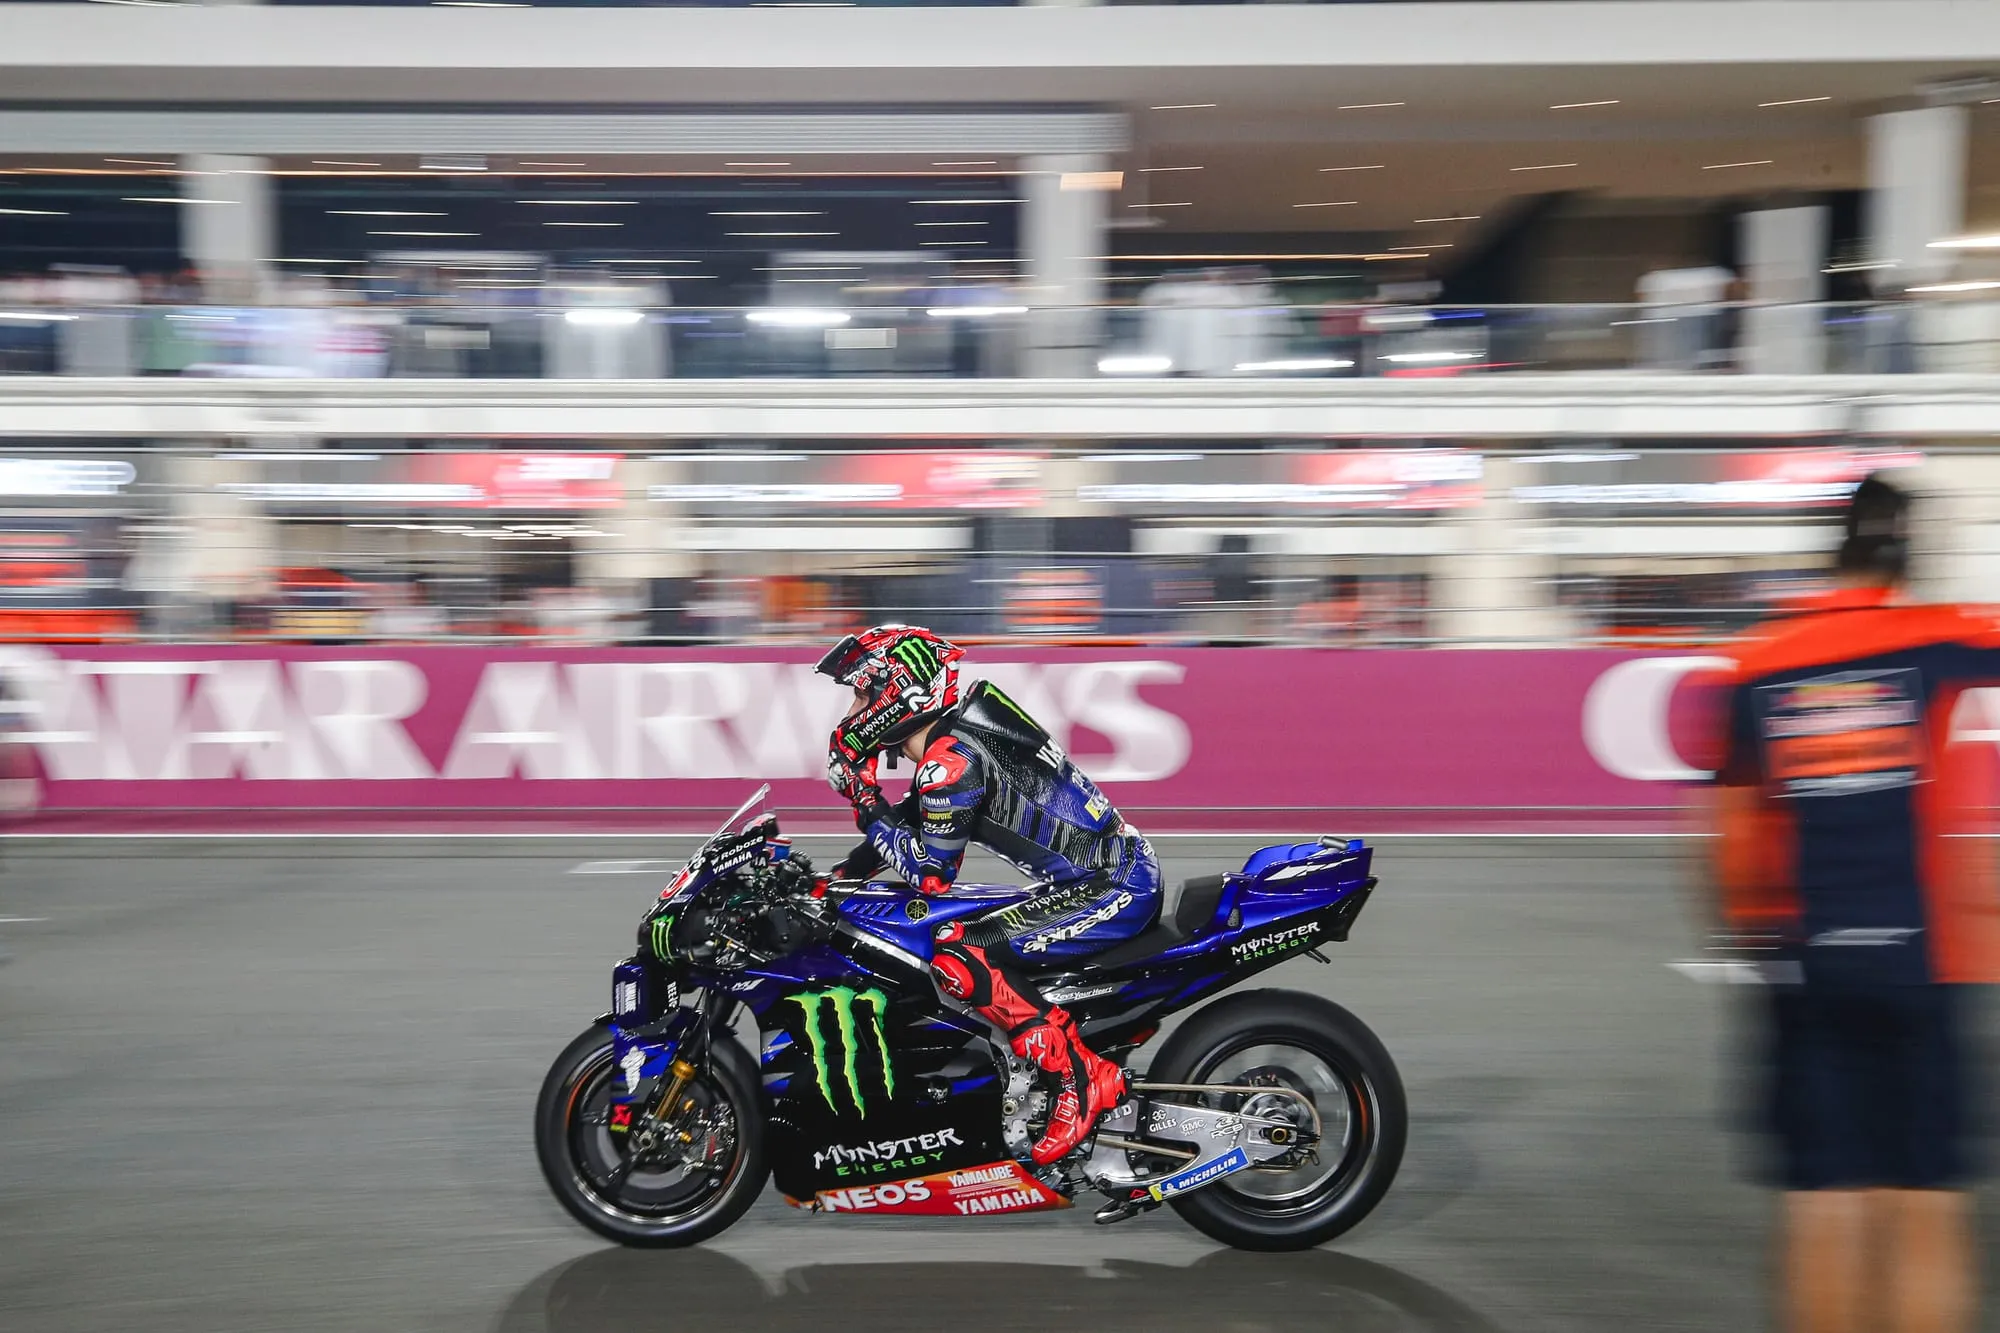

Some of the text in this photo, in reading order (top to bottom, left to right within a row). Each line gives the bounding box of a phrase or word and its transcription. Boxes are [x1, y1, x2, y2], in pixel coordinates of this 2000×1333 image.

[440, 661, 1192, 781] AIRWS
[859, 702, 904, 737] MONSTER
[720, 835, 764, 861] Roboze
[712, 851, 753, 875] YAMAHA
[1025, 883, 1089, 912] MONS
[1231, 921, 1321, 956] MONSTER
[1243, 935, 1310, 961] ENERGY
[1149, 1118, 1177, 1133] GILLES
[1181, 1119, 1205, 1132] BMC
[1210, 1122, 1244, 1139] RCB
[948, 1165, 1015, 1187] YAMALUBE
[1178, 1155, 1238, 1189] MICHELIN
[821, 1179, 932, 1213] NEOS
[953, 1187, 1046, 1216] YAMAHA
